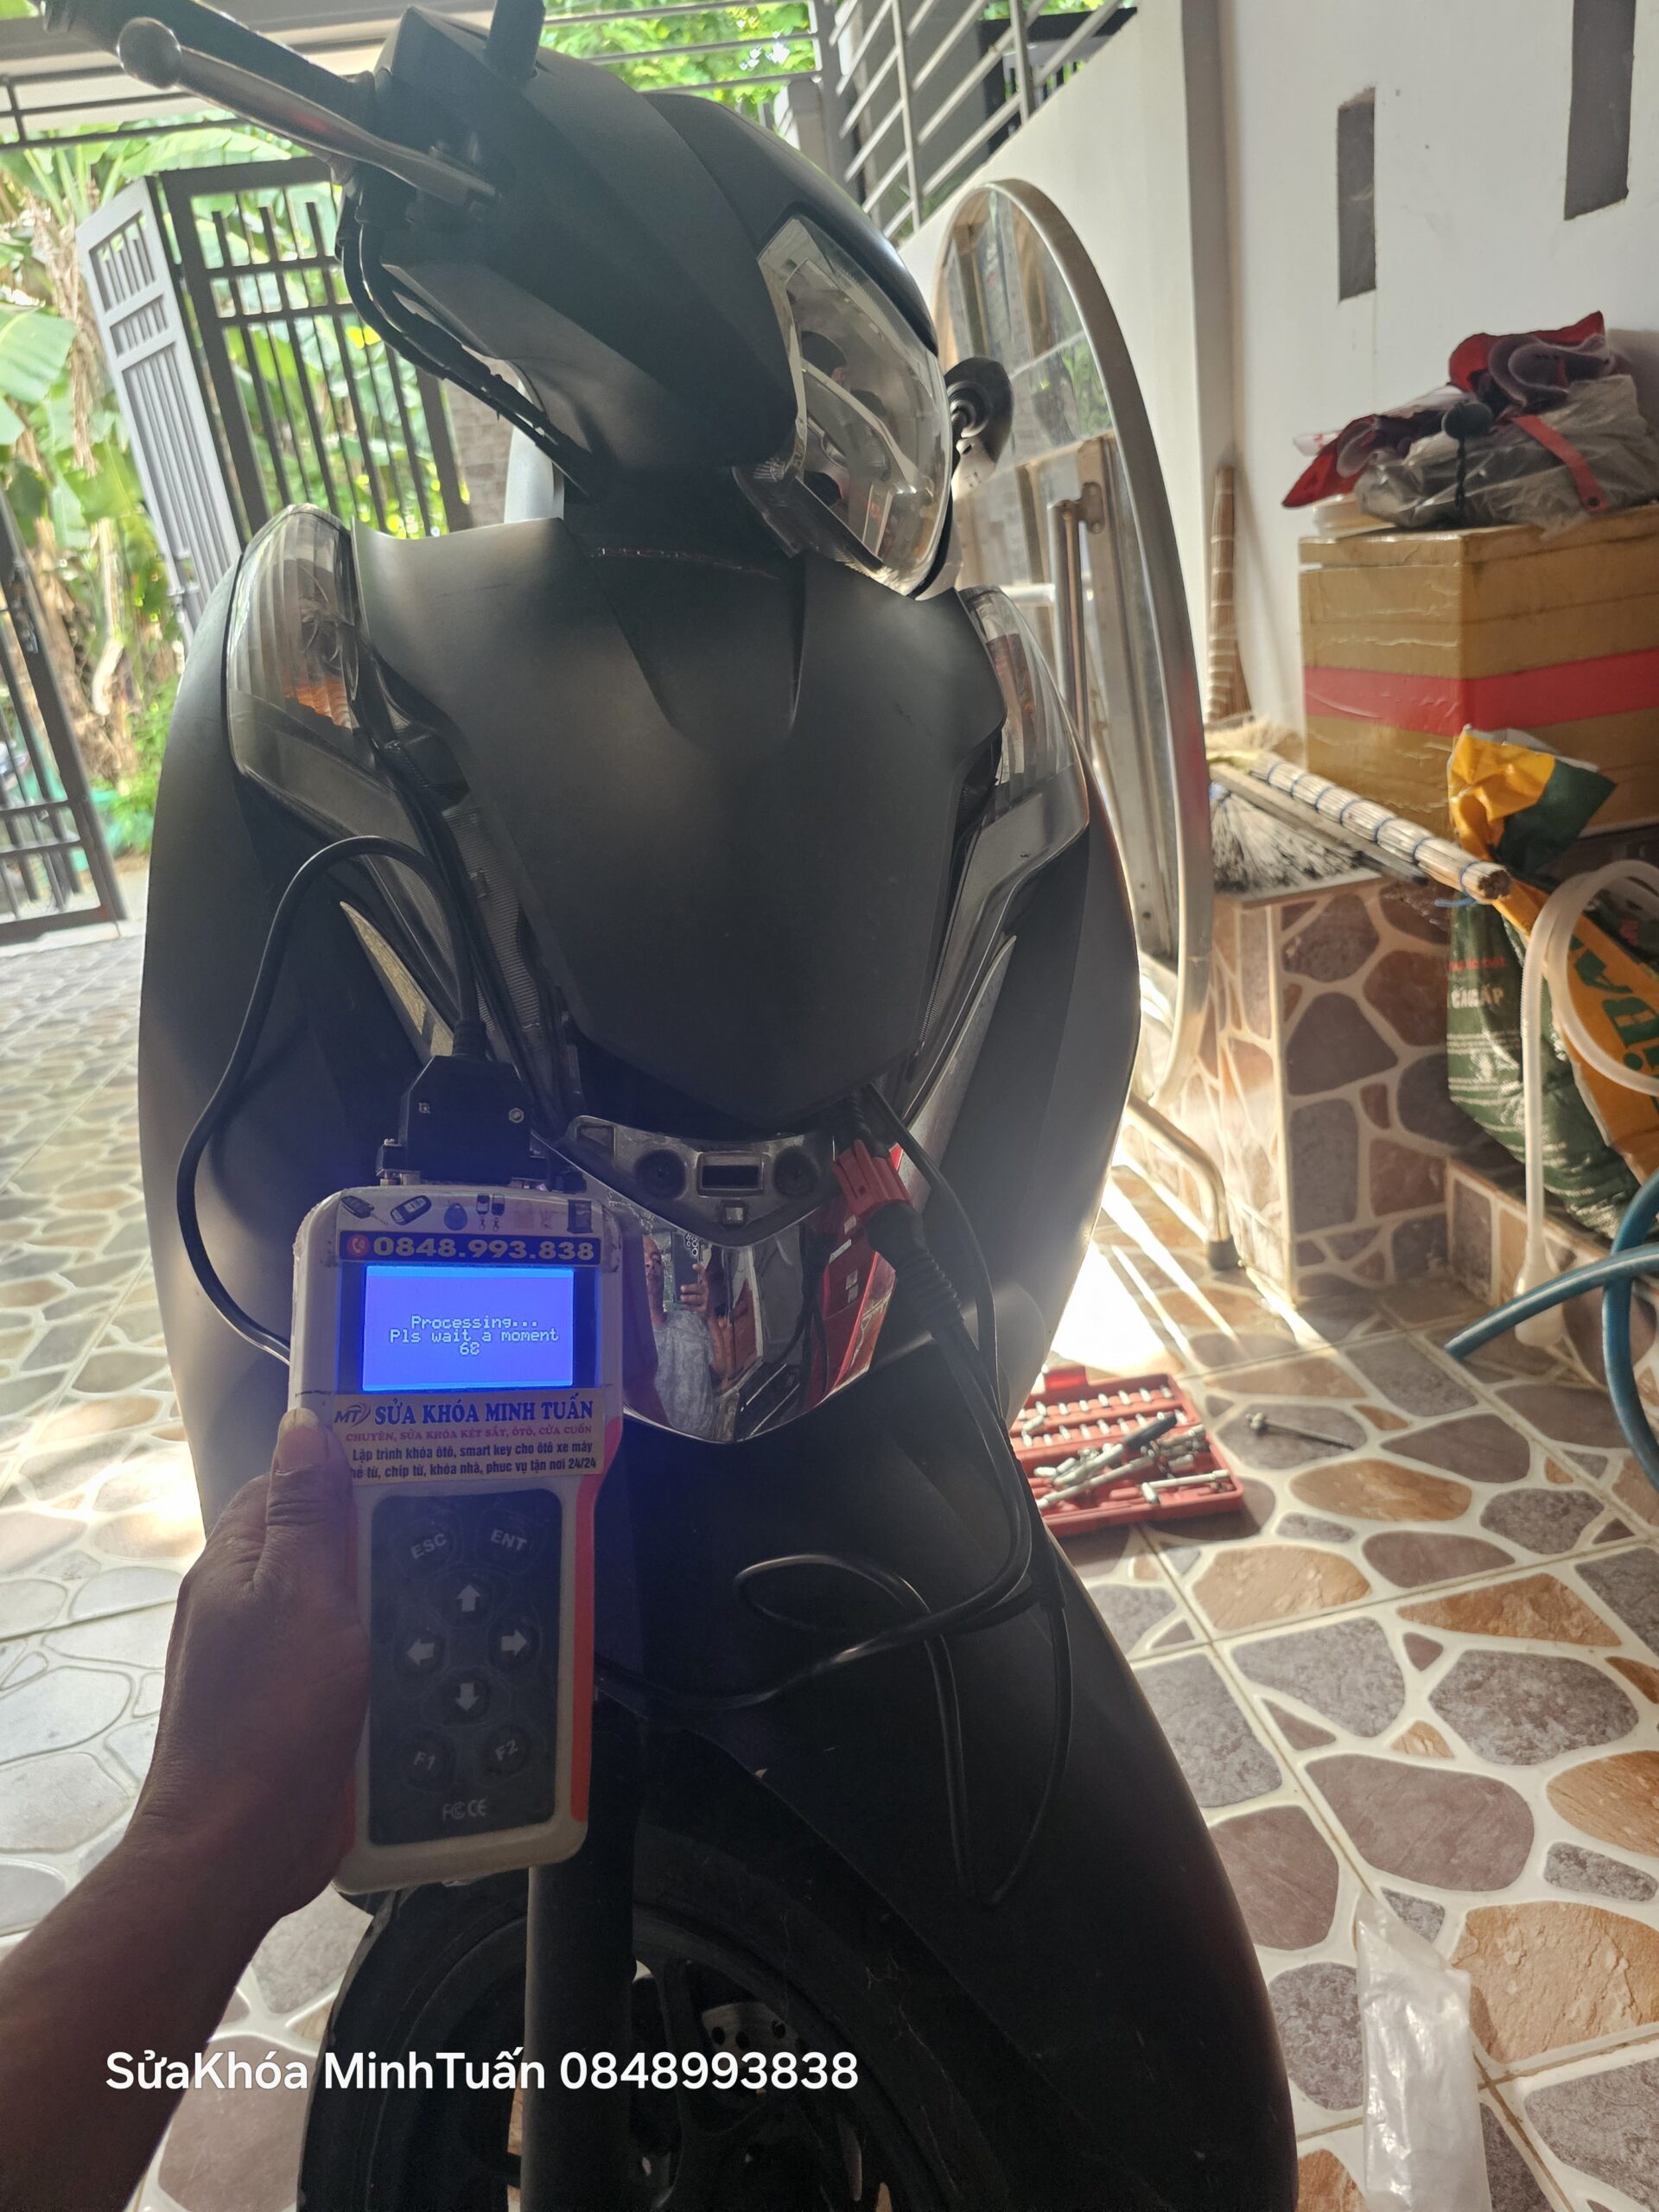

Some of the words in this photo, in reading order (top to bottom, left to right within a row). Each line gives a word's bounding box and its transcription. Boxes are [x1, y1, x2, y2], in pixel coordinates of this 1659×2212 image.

[373, 1237, 594, 1260] 0848.993.838
[410, 1315, 537, 1329] Processing...
[390, 1329, 421, 1343] Pls
[431, 1328, 472, 1342] wait
[481, 1332, 492, 1342] a
[501, 1328, 559, 1342] moment
[374, 1397, 416, 1425] SỬA
[423, 1398, 480, 1424] KHÓA
[486, 1402, 536, 1421] MINH
[541, 1392, 594, 1420] TUẤN
[460, 1445, 491, 1457] smart
[493, 1444, 512, 1457] key
[515, 1442, 534, 1455] cho
[556, 1443, 569, 1453] xe
[385, 1465, 410, 1478] chip
[568, 1457, 597, 1470] 24/24
[410, 1532, 448, 1560] ESC
[490, 1529, 528, 1552] ENT
[494, 1738, 520, 1761] F2
[413, 1751, 436, 1770] F1
